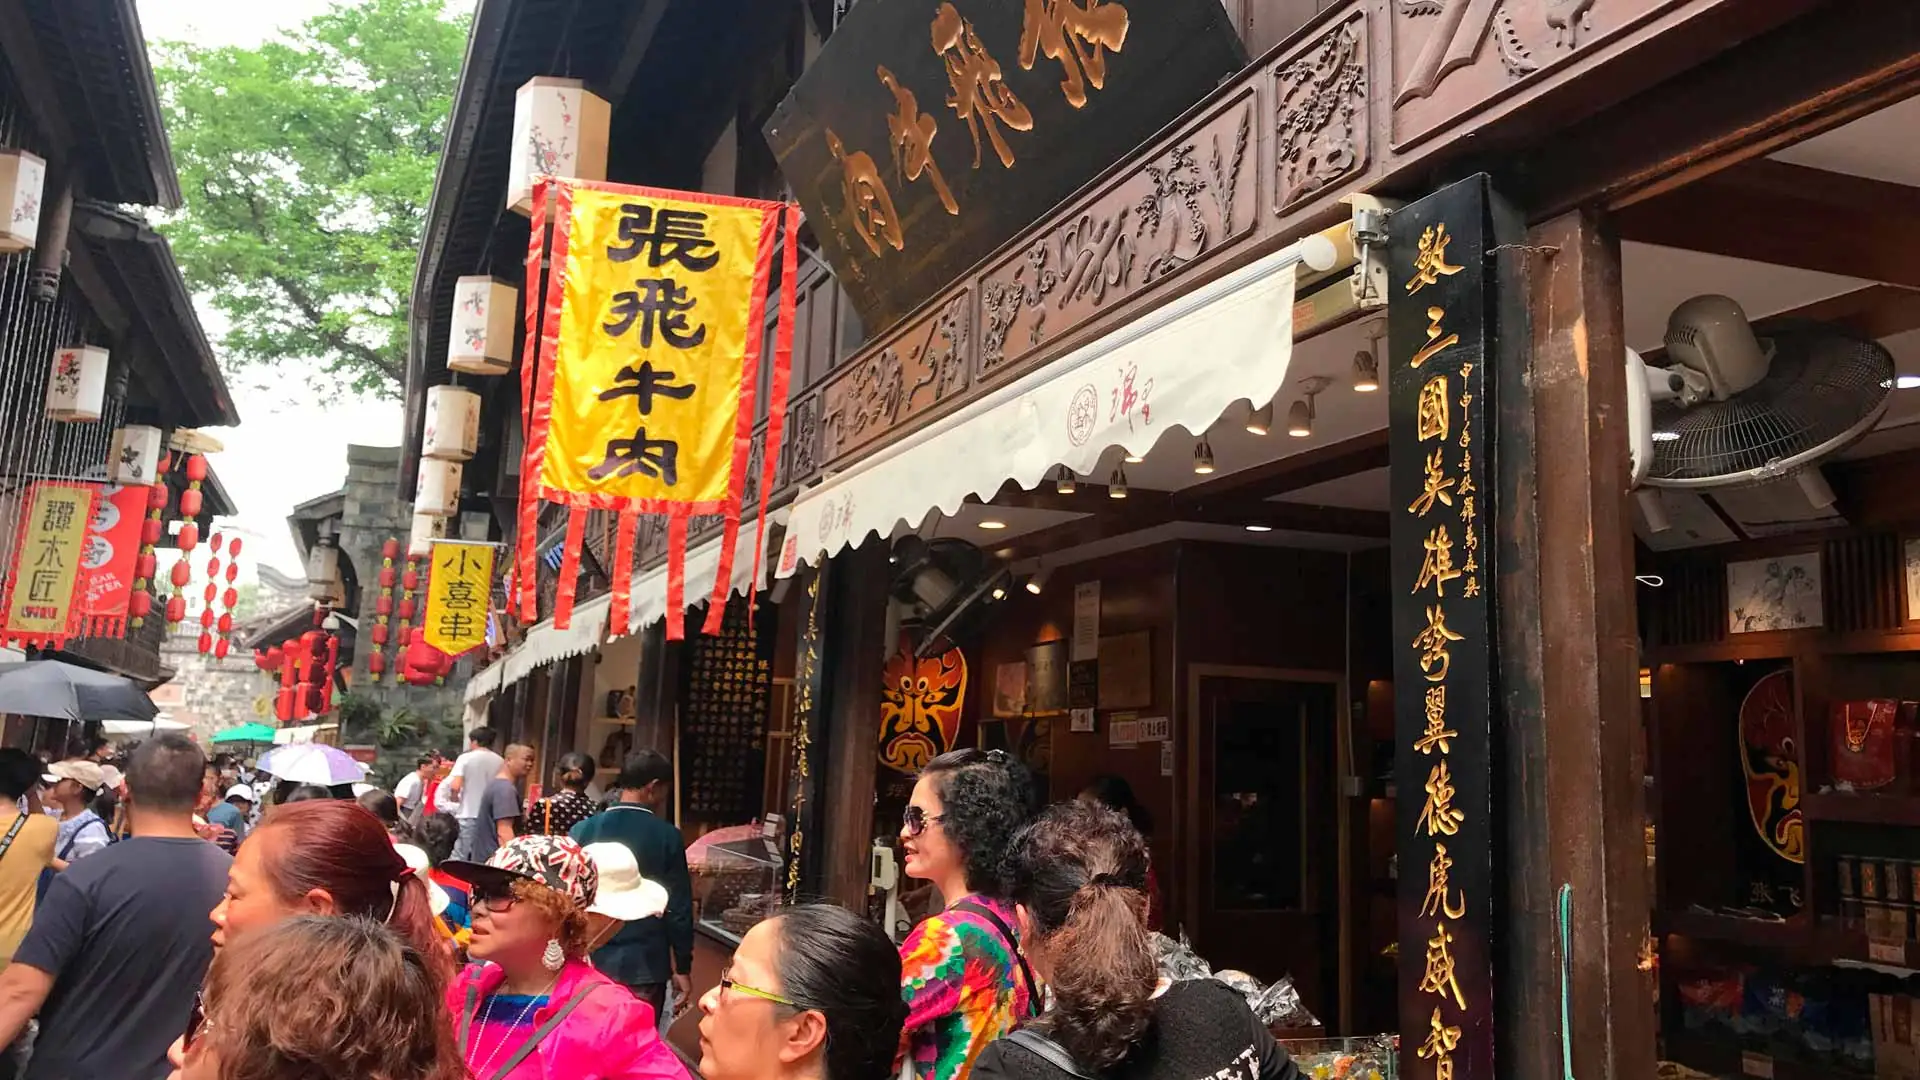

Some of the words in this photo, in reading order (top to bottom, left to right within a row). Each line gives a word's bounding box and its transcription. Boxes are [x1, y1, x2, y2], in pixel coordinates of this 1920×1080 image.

[587, 203, 720, 486] 張飛牛肉
[439, 549, 483, 641] 小喜串
